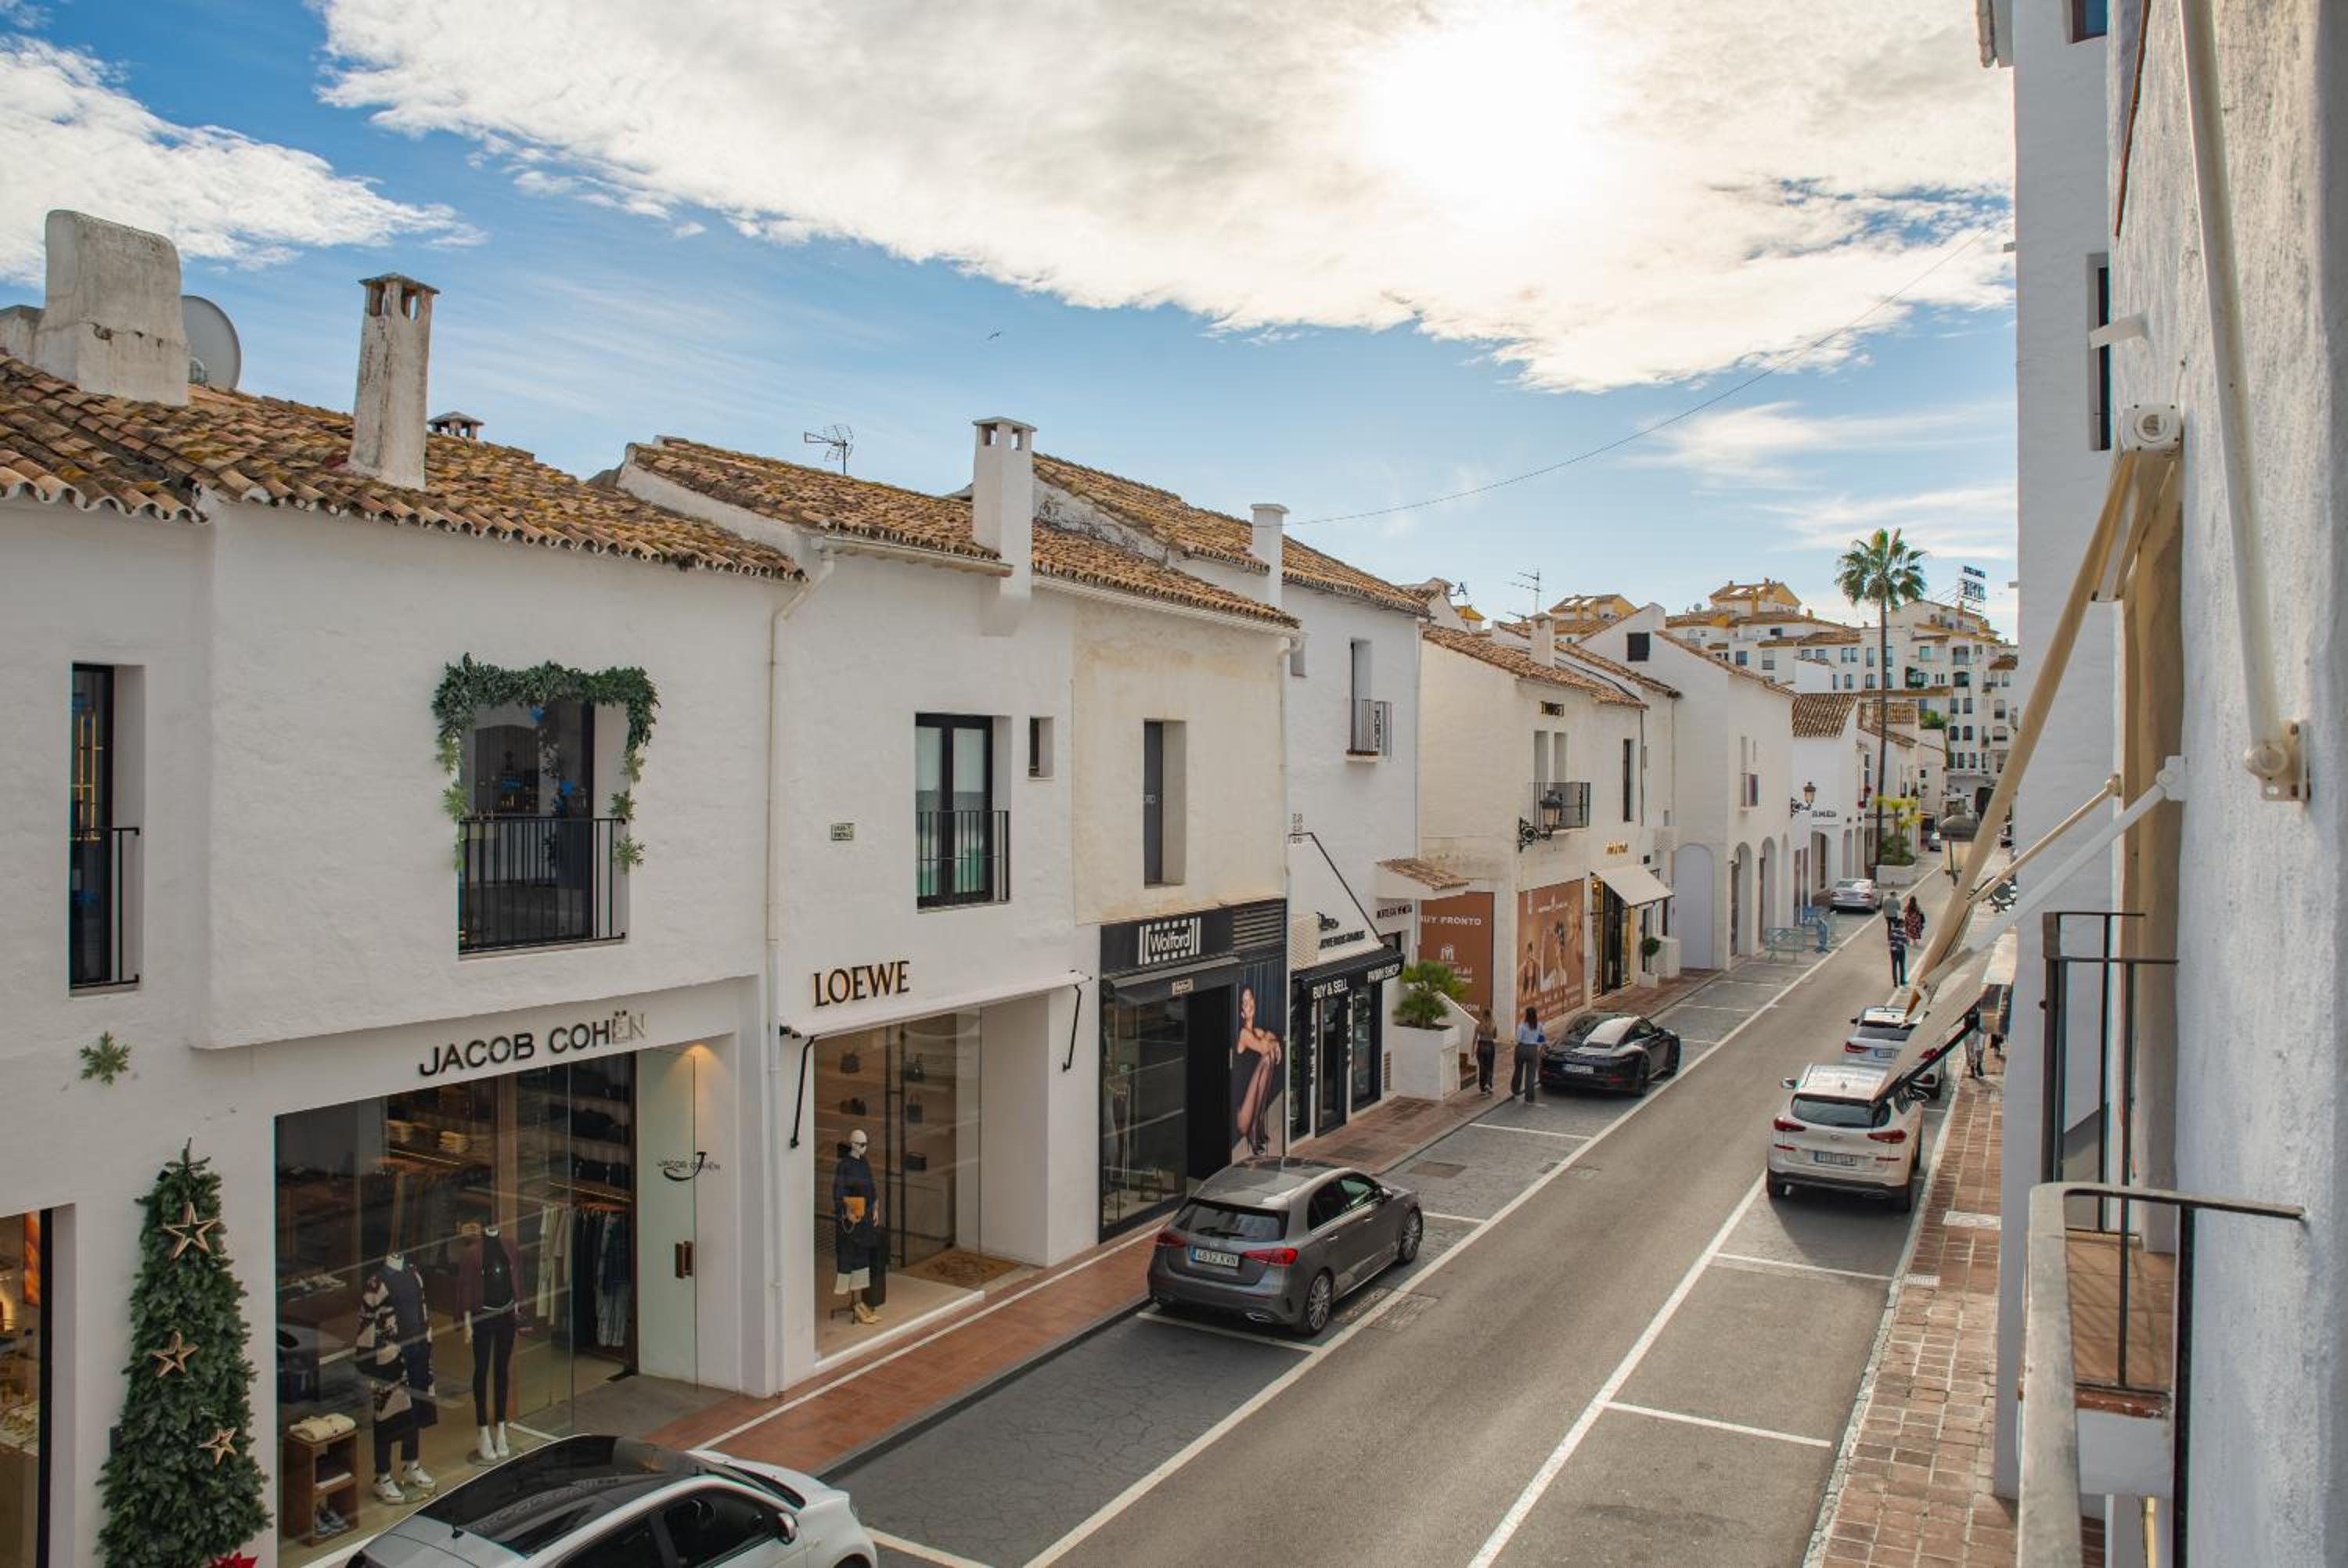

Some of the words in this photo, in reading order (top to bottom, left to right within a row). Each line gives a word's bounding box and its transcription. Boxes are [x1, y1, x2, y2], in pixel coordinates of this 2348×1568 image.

[1440, 916, 1482, 926] PRONTO
[1150, 928, 1190, 952] Wolford
[1384, 963, 1400, 979] SHOP
[813, 959, 910, 1007] LOEWE
[1313, 985, 1326, 999] BUY
[1327, 982, 1333, 996] &
[1333, 978, 1349, 994] SELL
[419, 1031, 535, 1077] JACOB
[548, 1010, 646, 1054] COHËN
